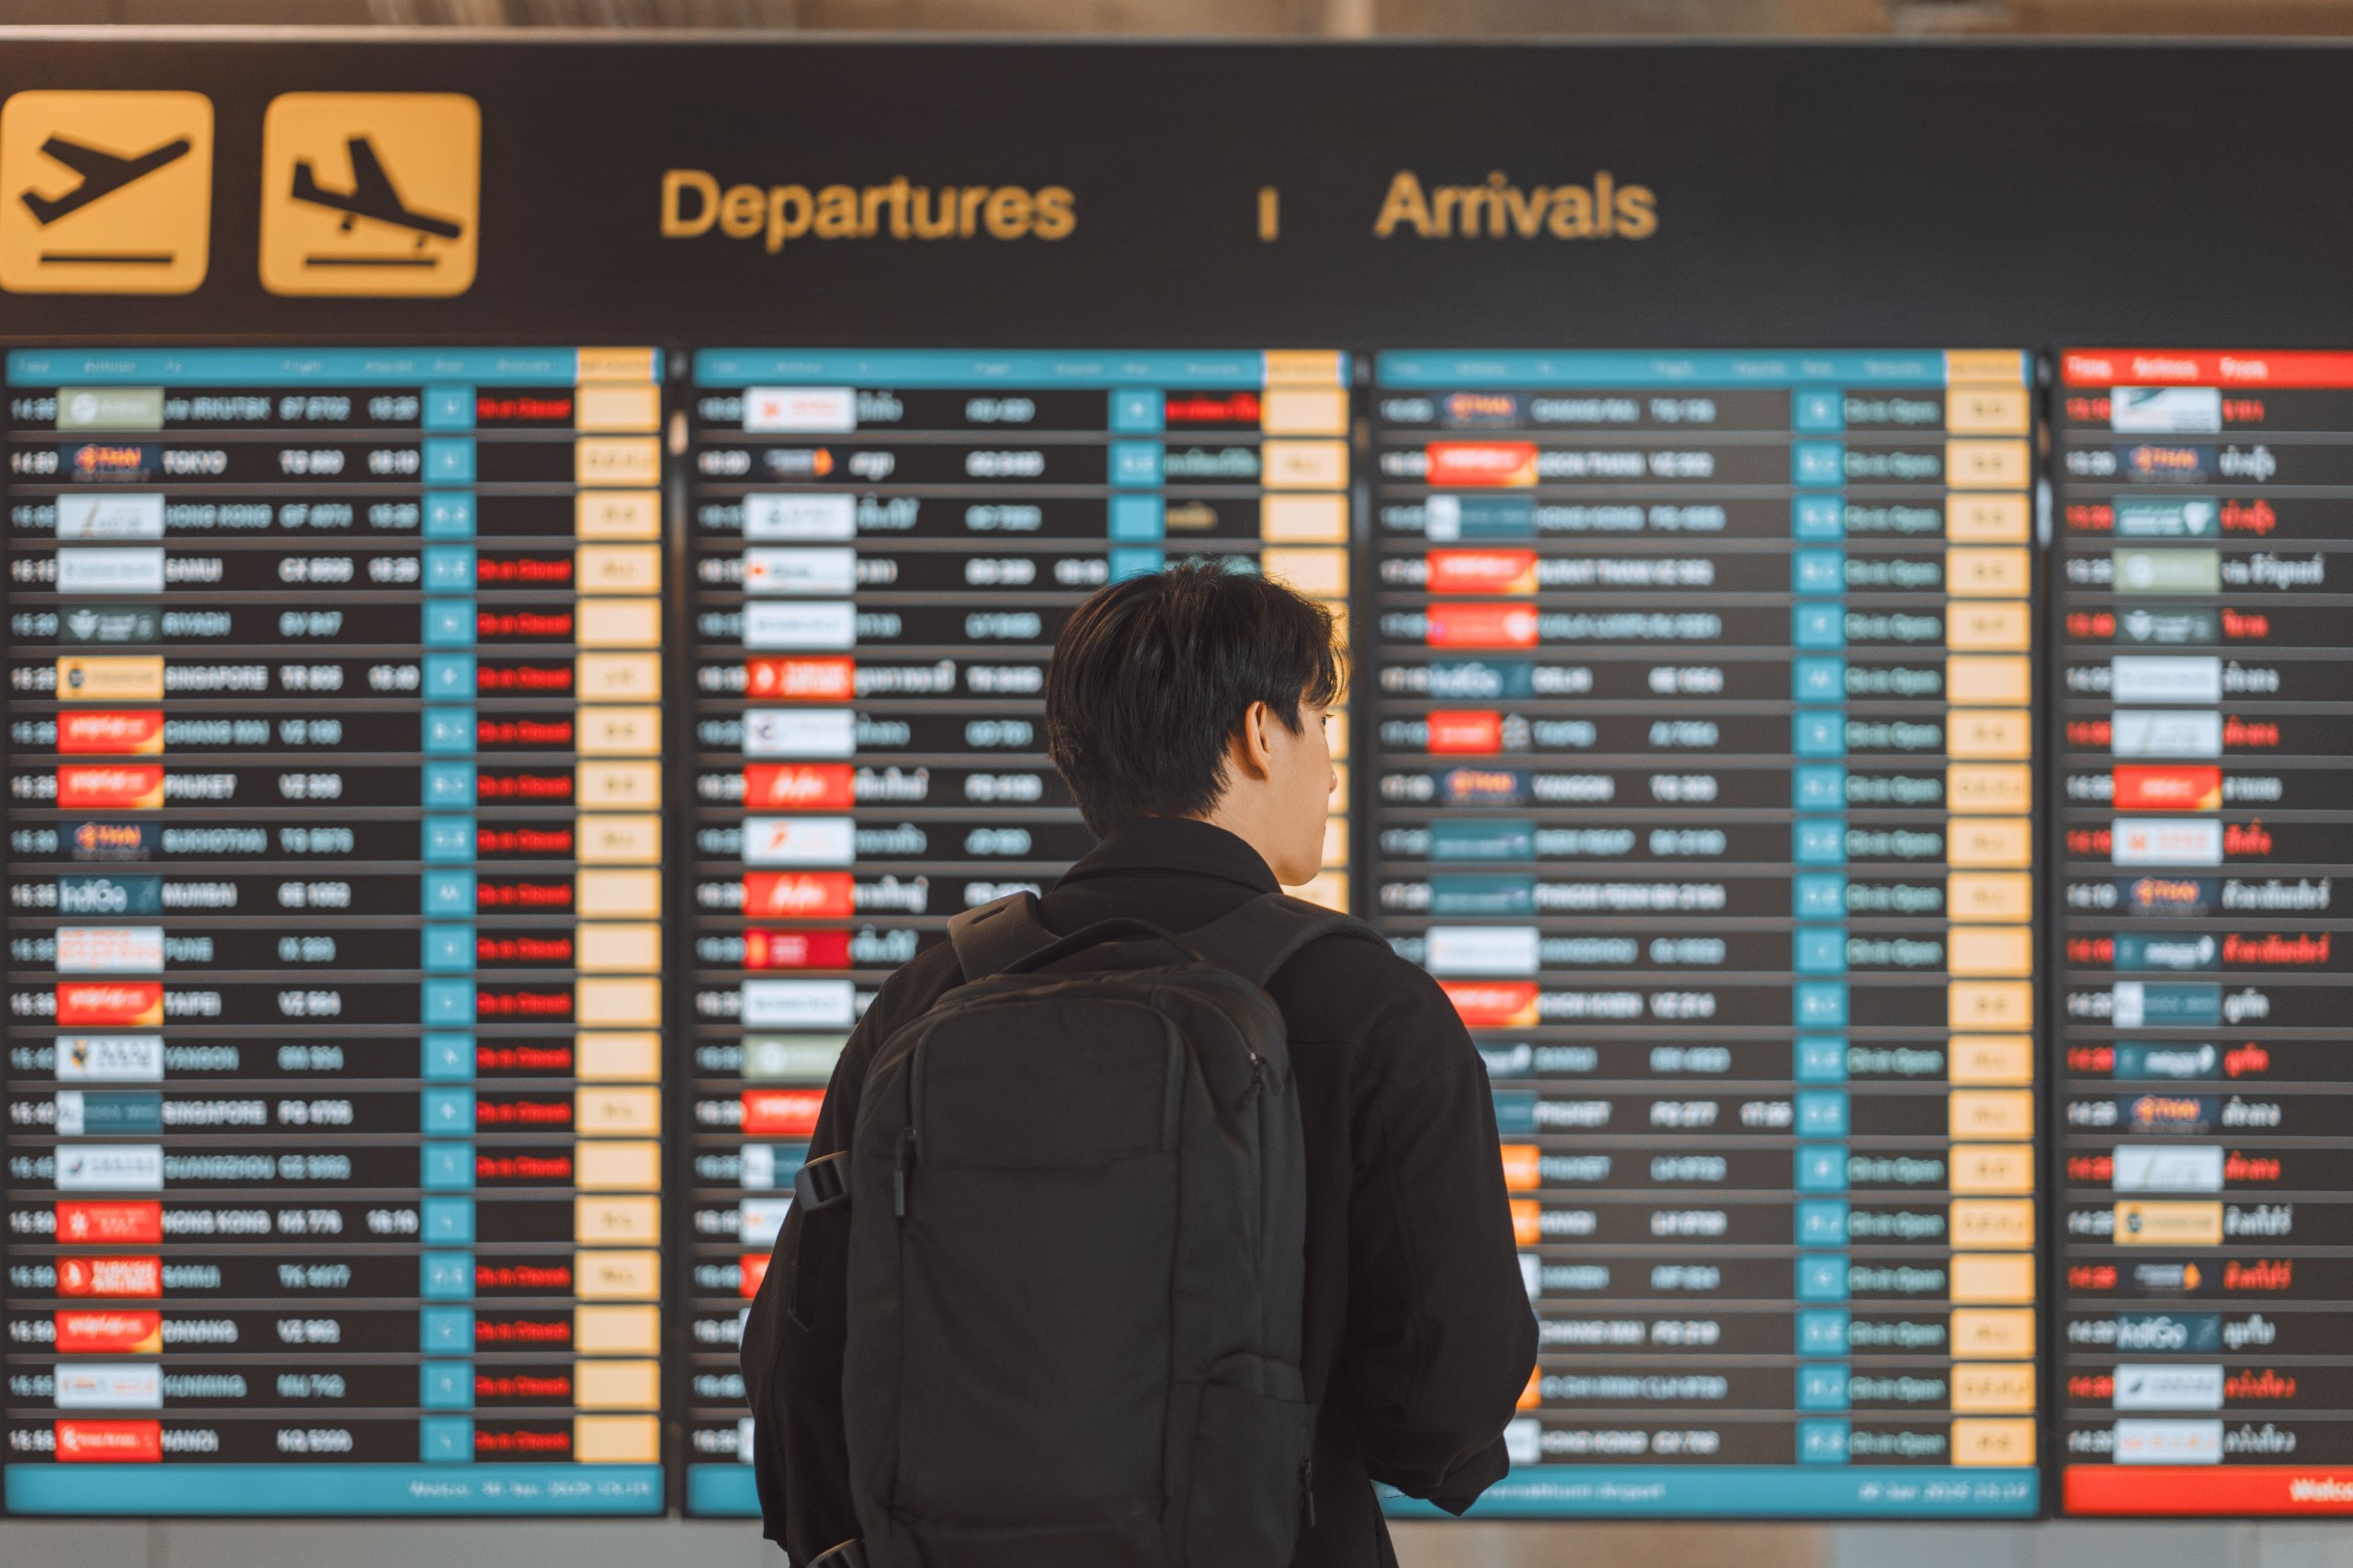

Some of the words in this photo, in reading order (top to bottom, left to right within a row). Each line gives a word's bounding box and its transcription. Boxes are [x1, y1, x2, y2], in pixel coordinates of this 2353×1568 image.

[660, 170, 1077, 254] Departures
[1375, 171, 1658, 241] Arrivals
[163, 451, 227, 473] TOKYO
[166, 666, 267, 689] SINGAPORE
[166, 775, 234, 798] PHUKET
[163, 883, 237, 906] MUMBAI
[166, 1101, 267, 1124] SINGAPORE
